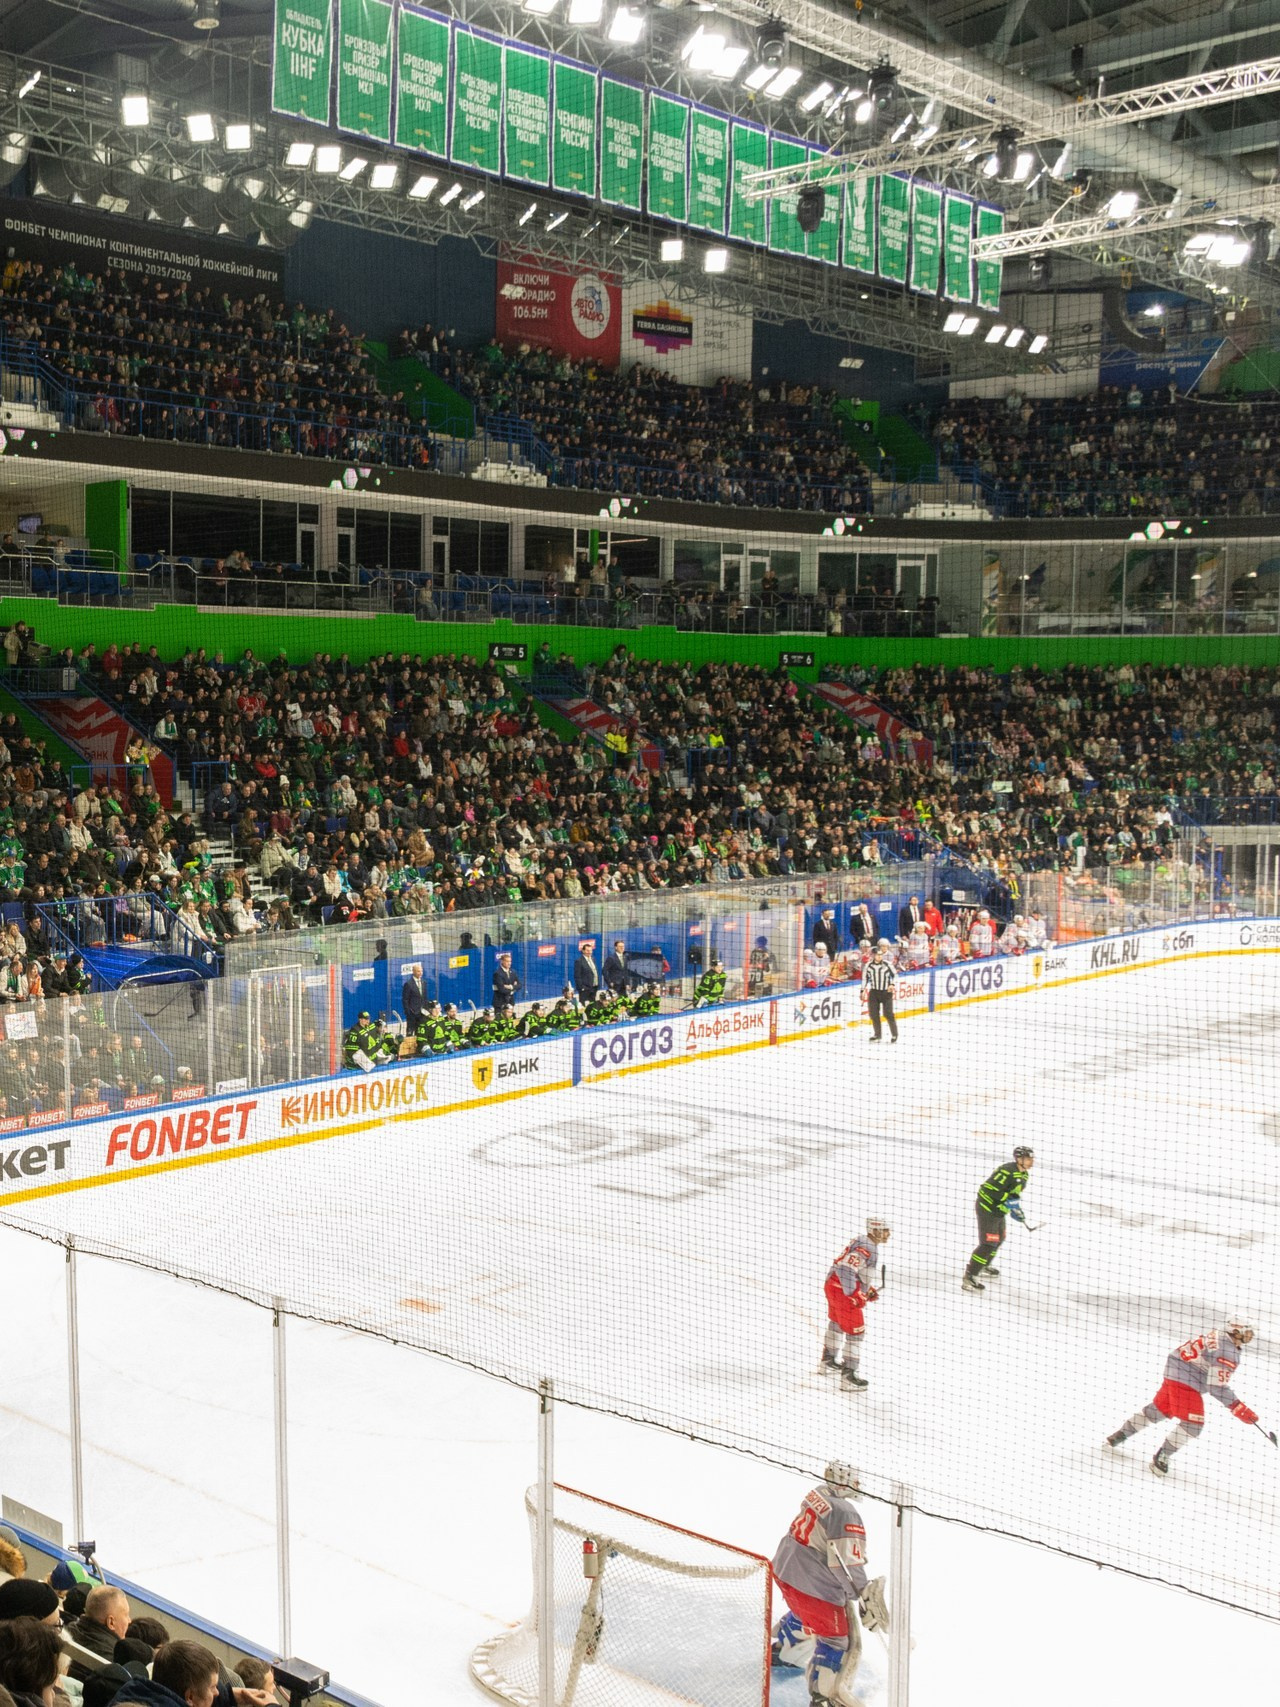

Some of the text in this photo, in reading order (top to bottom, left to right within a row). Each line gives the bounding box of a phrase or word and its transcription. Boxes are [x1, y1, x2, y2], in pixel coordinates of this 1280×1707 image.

[282, 22, 325, 58] КУБКА
[344, 34, 388, 59] БРОНЗОВЫЙ
[290, 51, 317, 80] IIHF
[342, 61, 388, 87] ЧЕМПИОНАТА
[556, 108, 594, 134] ЧЕМПИОН
[560, 127, 590, 150] РОССИИ
[4, 218, 278, 283] ФОНБЕТ ЧЕМПИОНАТ КОНТИНЕНТАЛЬНОЙ ХОККЕЙНОЙ ЛИГИ
[107, 256, 192, 282] СЕЗОНА 2025/2026
[513, 273, 550, 286] ВКЛЮЧИ
[574, 298, 595, 311] АВТО
[578, 308, 605, 323] РАДИО
[636, 320, 657, 331] TERRA
[493, 646, 499, 657] 4
[518, 647, 524, 658] 5
[783, 654, 788, 664] 5
[806, 655, 812, 665] 6
[1172, 931, 1194, 951] сбп
[1044, 957, 1068, 971] БАНК
[1091, 938, 1140, 969] KHL.RU
[899, 981, 925, 999] Банк
[946, 963, 1004, 998] согаз
[810, 997, 842, 1022] сбп
[686, 1010, 765, 1042] Альфа Банк
[589, 1025, 674, 1069] согаз
[497, 1056, 539, 1079] БАНК
[124, 1095, 157, 1109] FONBET
[172, 1087, 204, 1100] FONBET
[281, 1071, 429, 1129] КИНОПОИСК
[29, 1111, 65, 1126] FONBET
[73, 1104, 108, 1118] FONBET
[106, 1101, 257, 1167] FONBET
[848, 1255, 860, 1268] 62
